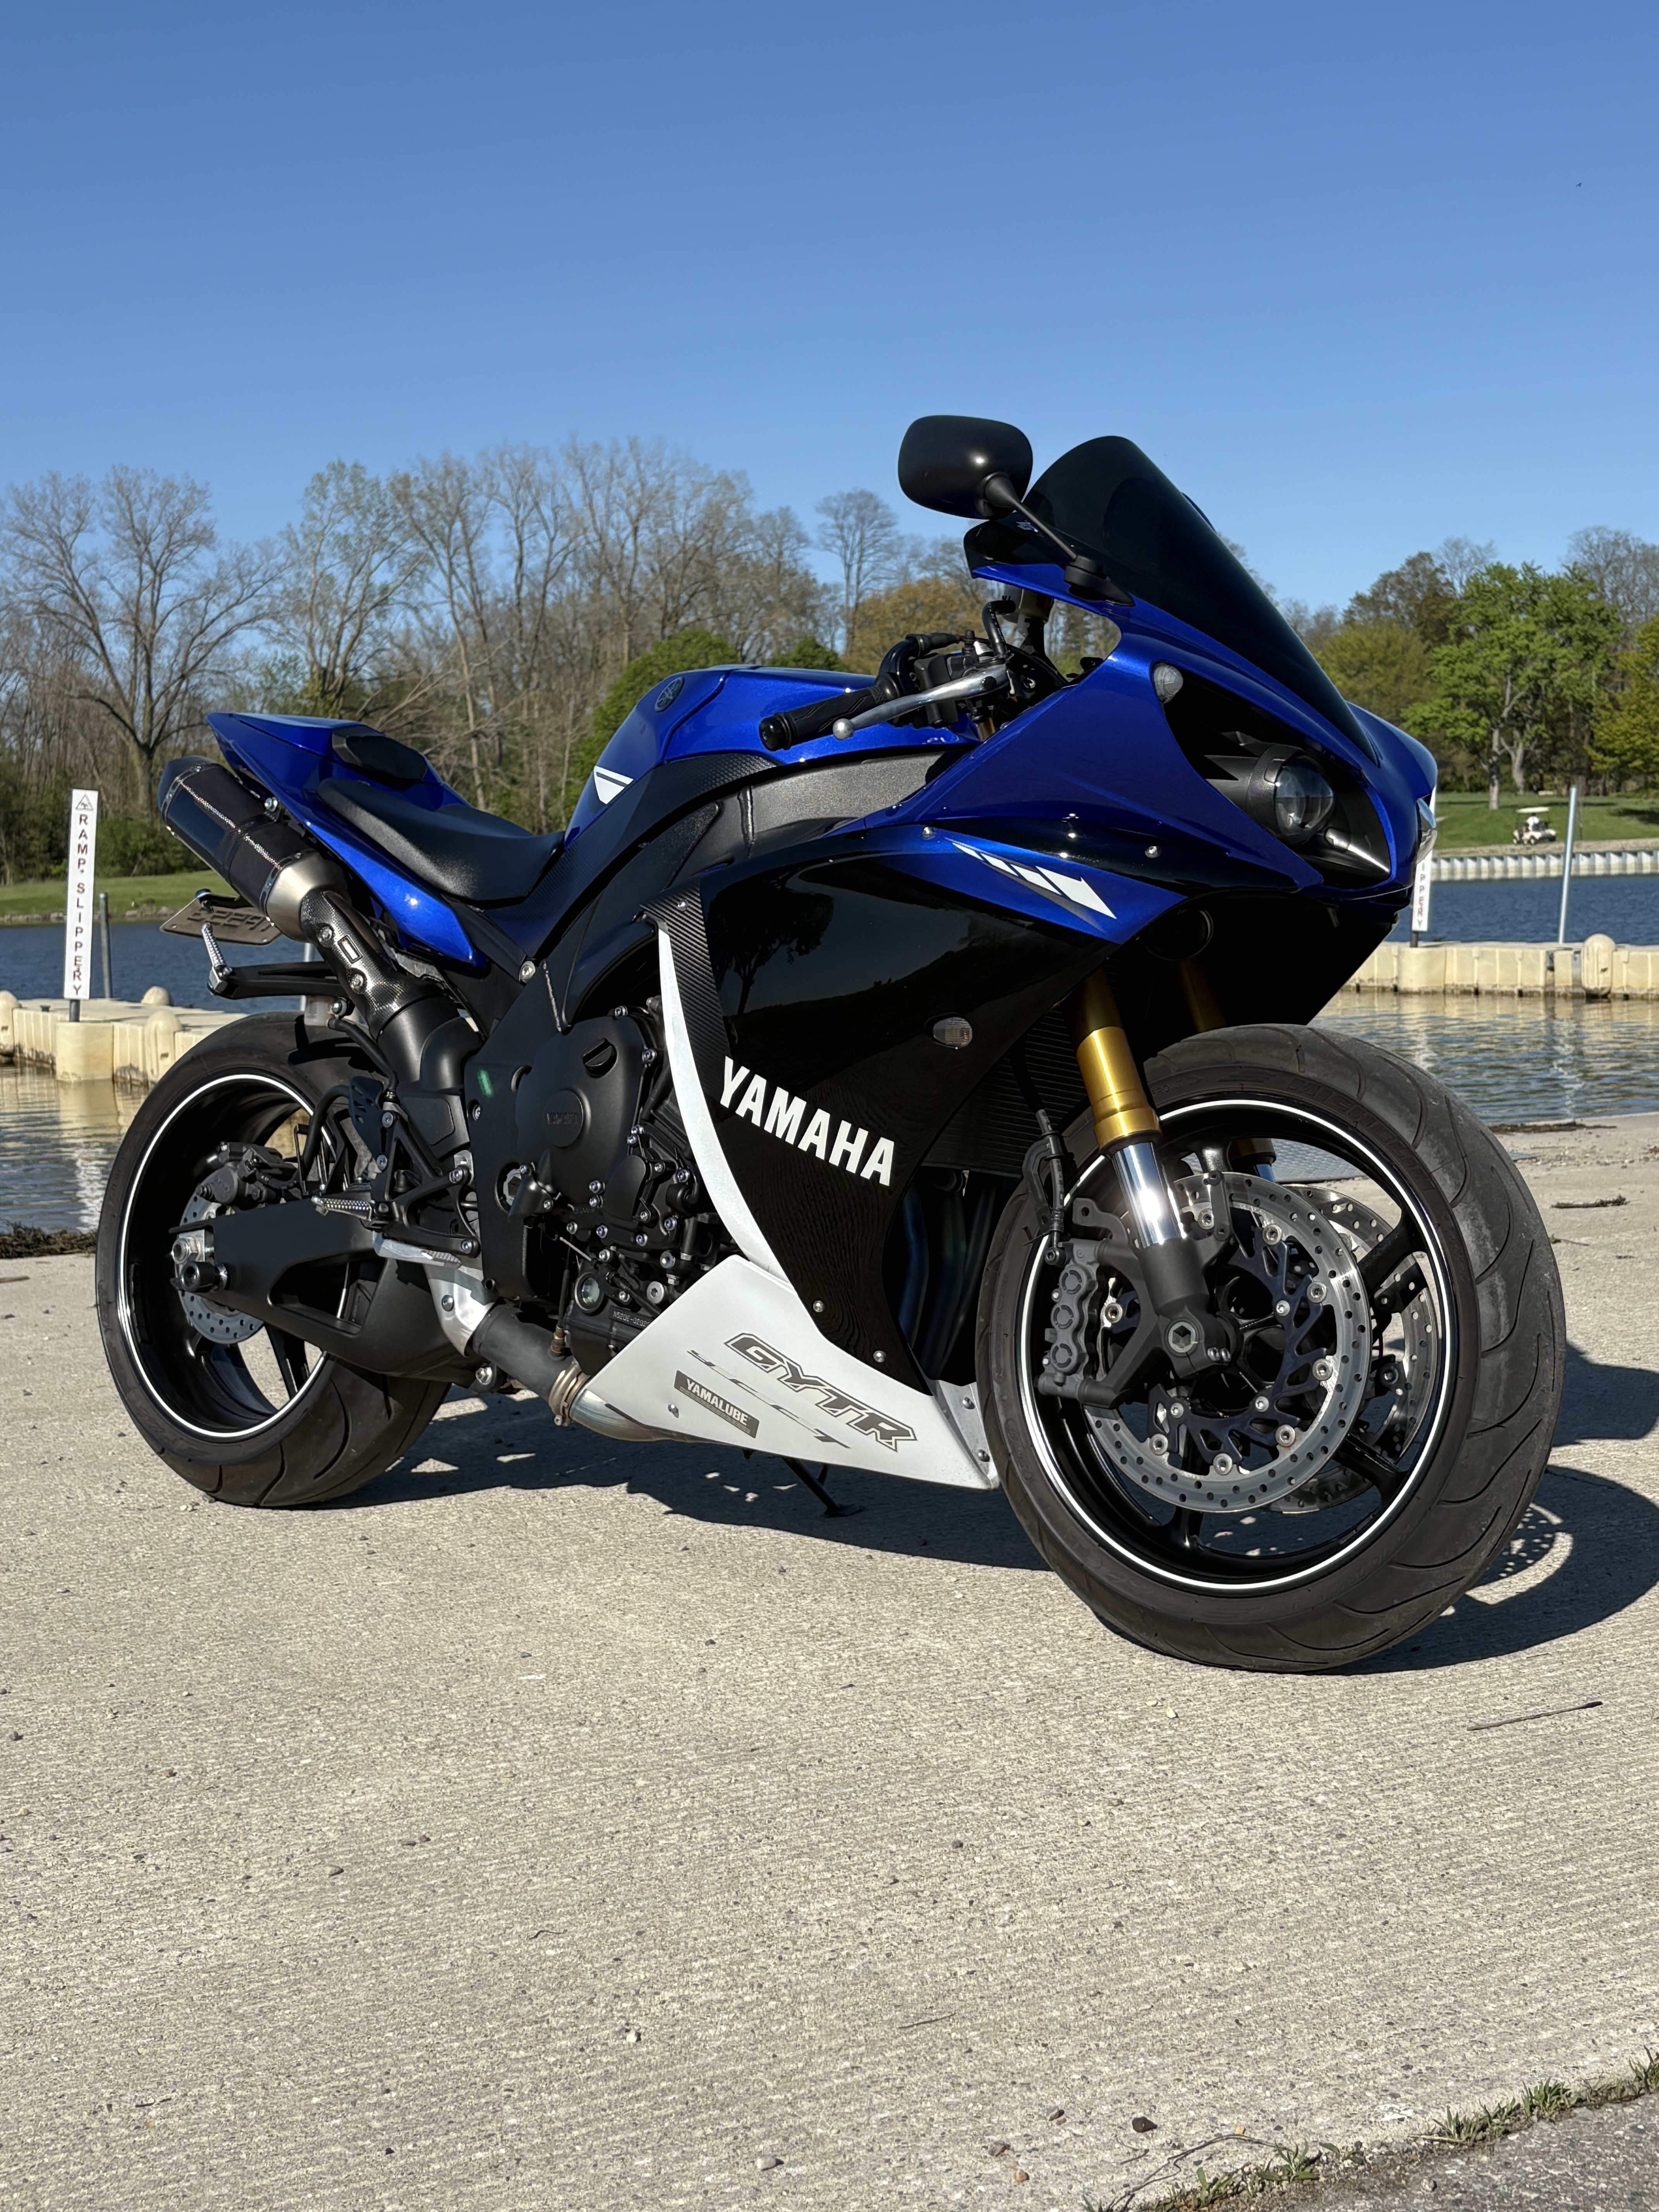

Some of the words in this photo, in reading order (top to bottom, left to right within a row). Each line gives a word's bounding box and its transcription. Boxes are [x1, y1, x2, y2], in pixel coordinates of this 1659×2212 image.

[77, 814, 88, 869] RAMP
[1417, 862, 1425, 928] IPPERY
[73, 883, 85, 996] SLIPPERY
[720, 1056, 895, 1186] YAMAHA
[1288, 1078, 1436, 1191] MICHELIN
[687, 1377, 748, 1425] YAMALUBE
[724, 1333, 918, 1452] GYTR
